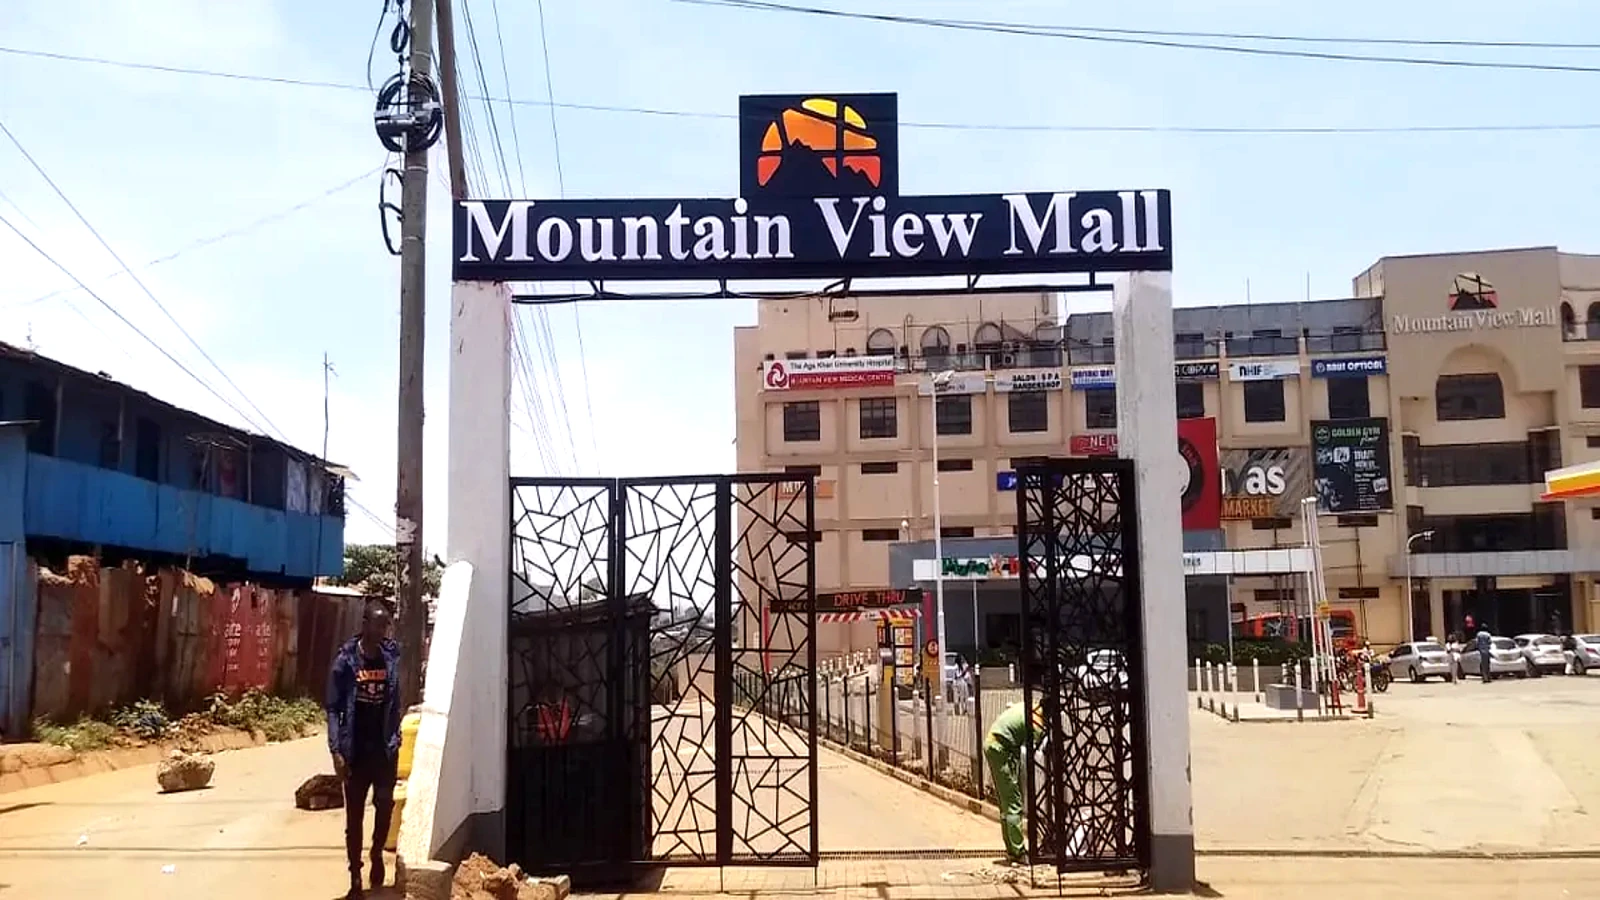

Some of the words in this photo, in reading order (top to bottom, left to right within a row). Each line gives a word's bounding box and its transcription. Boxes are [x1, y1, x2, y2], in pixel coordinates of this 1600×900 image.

[459, 198, 794, 261] Mountain
[814, 196, 983, 258] View
[1002, 189, 1165, 256] Mall
[1393, 312, 1474, 333] Mountain
[1474, 310, 1515, 330] View
[1517, 306, 1557, 327] Mall
[789, 362, 802, 370] The
[803, 361, 816, 371] Aga
[817, 360, 833, 369] Khan
[834, 359, 865, 369] University
[866, 358, 892, 368] Hospital
[1012, 374, 1036, 382] SALON
[833, 592, 869, 607] DRIVE
[876, 590, 906, 604] THRU
